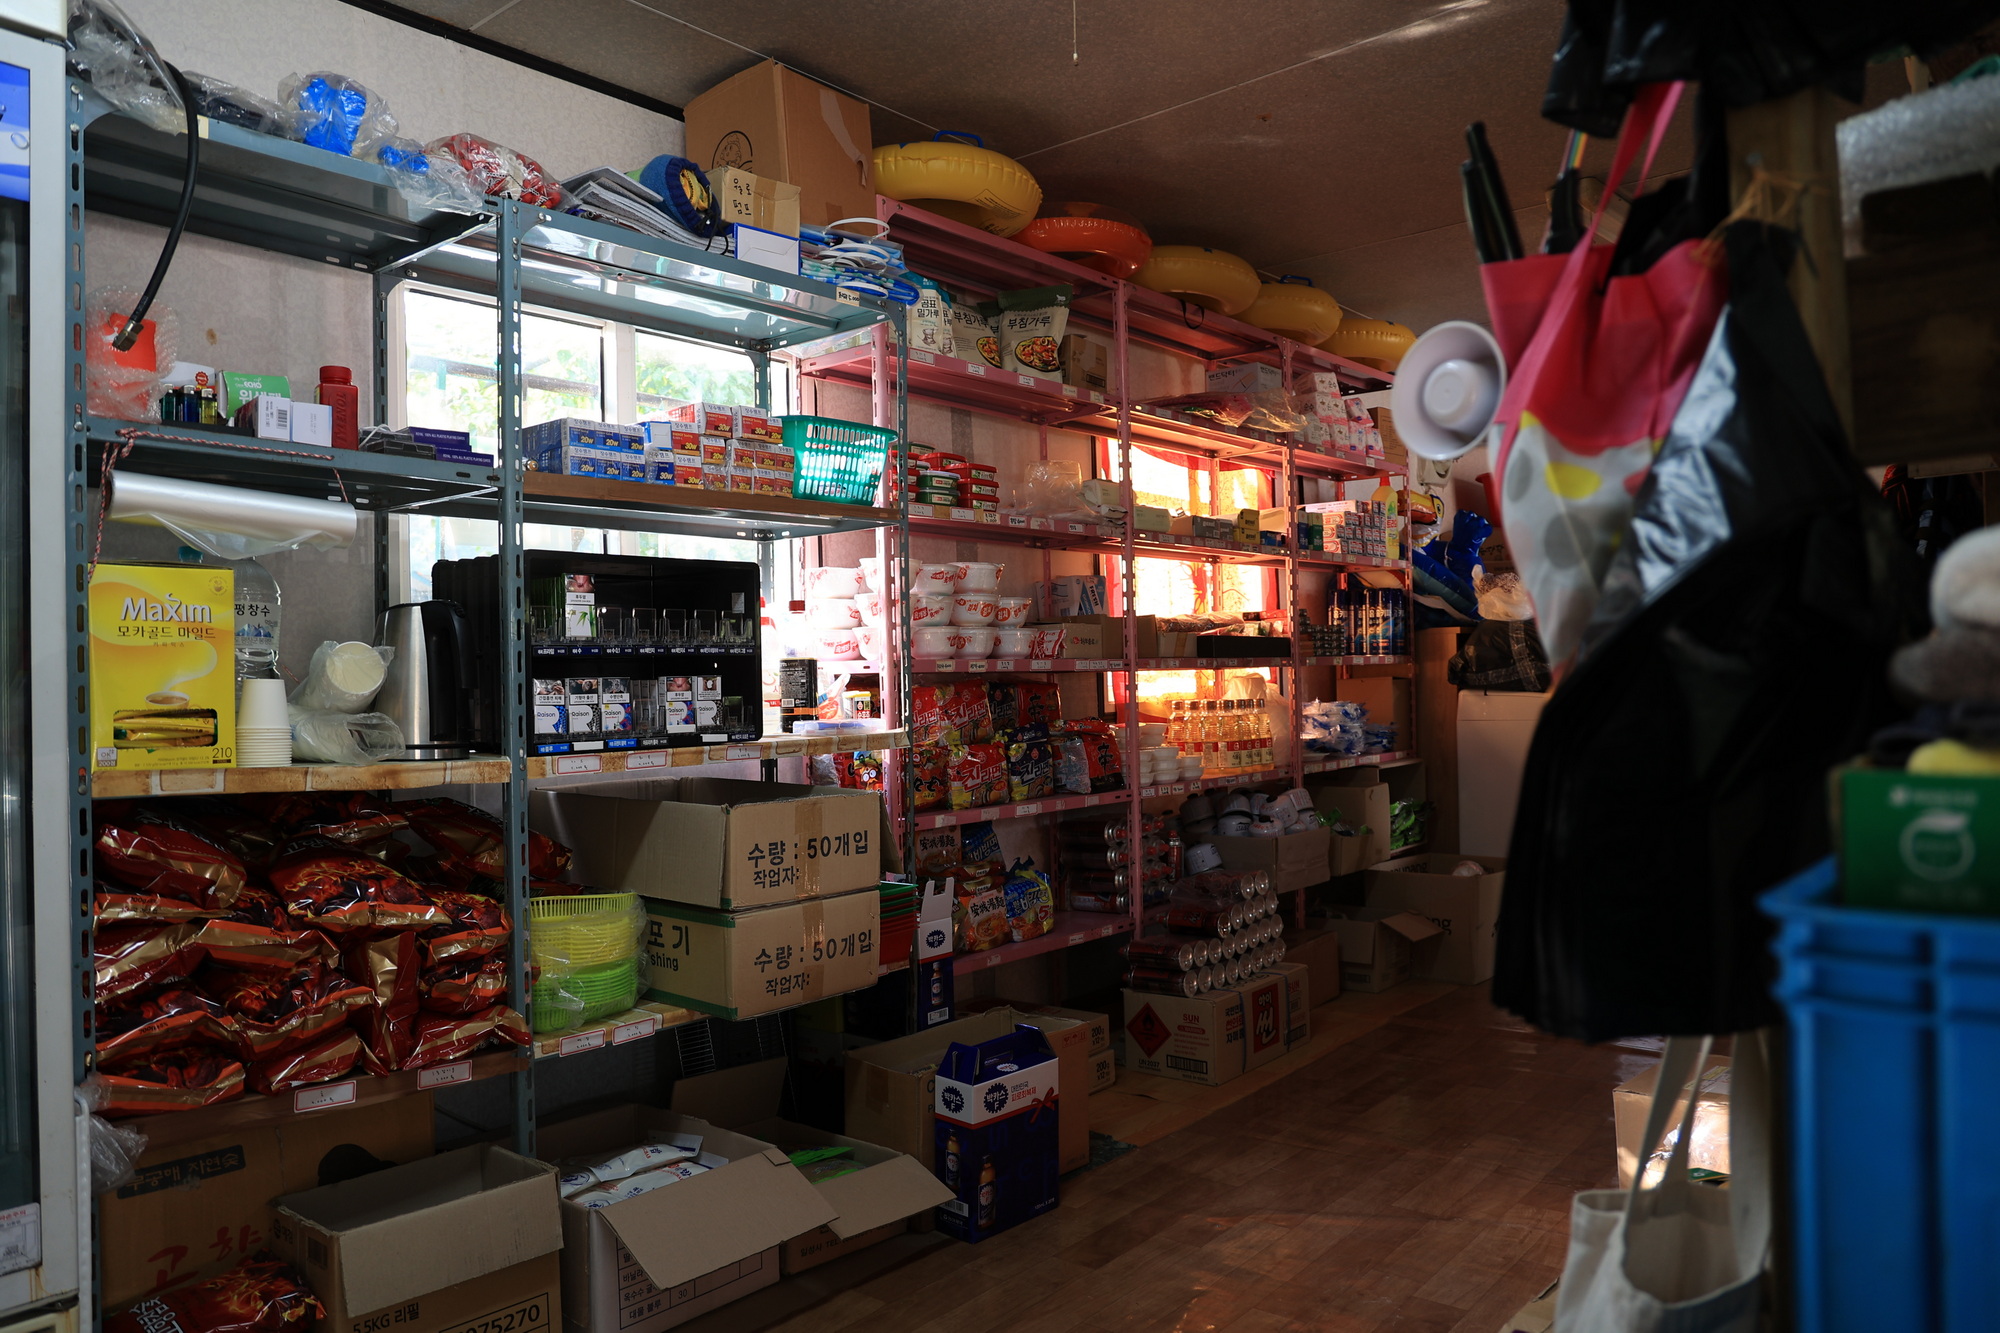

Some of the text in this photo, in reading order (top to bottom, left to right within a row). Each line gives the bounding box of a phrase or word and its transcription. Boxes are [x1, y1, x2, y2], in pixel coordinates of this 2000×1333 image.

[921, 299, 937, 309] 곰표
[917, 308, 940, 319] 밀가루
[954, 311, 989, 328] 부침가루
[1007, 316, 1050, 330] 부침가루
[1090, 585, 1100, 606] FRESH
[120, 593, 213, 623] Maxim
[117, 626, 216, 640] 모카골드 마일드
[951, 702, 986, 730] 진라면
[212, 747, 233, 758] 210
[962, 760, 1001, 792] 진라면
[1021, 760, 1051, 786] 진라면
[748, 840, 786, 869] 수량
[808, 830, 869, 859] 50개입
[754, 866, 800, 889] 작업자:
[754, 945, 793, 973] 수량
[812, 930, 873, 962] 50개입
[648, 952, 679, 971] shing
[765, 972, 810, 997] 작업자:
[1183, 1013, 1200, 1023] SUN
[1010, 1081, 1029, 1093] 대한민국
[1011, 1086, 1037, 1102] 피로회복제
[944, 1092, 962, 1104] 박카스
[986, 1092, 1008, 1102] 박카스
[994, 1101, 999, 1110] F
[188, 1153, 240, 1175] 자연숯
[826, 1238, 838, 1248] TEL
[623, 1270, 644, 1282] 바닐라
[624, 1288, 644, 1301] 옥수수
[678, 1288, 688, 1299] 30
[394, 1302, 419, 1323] 리필
